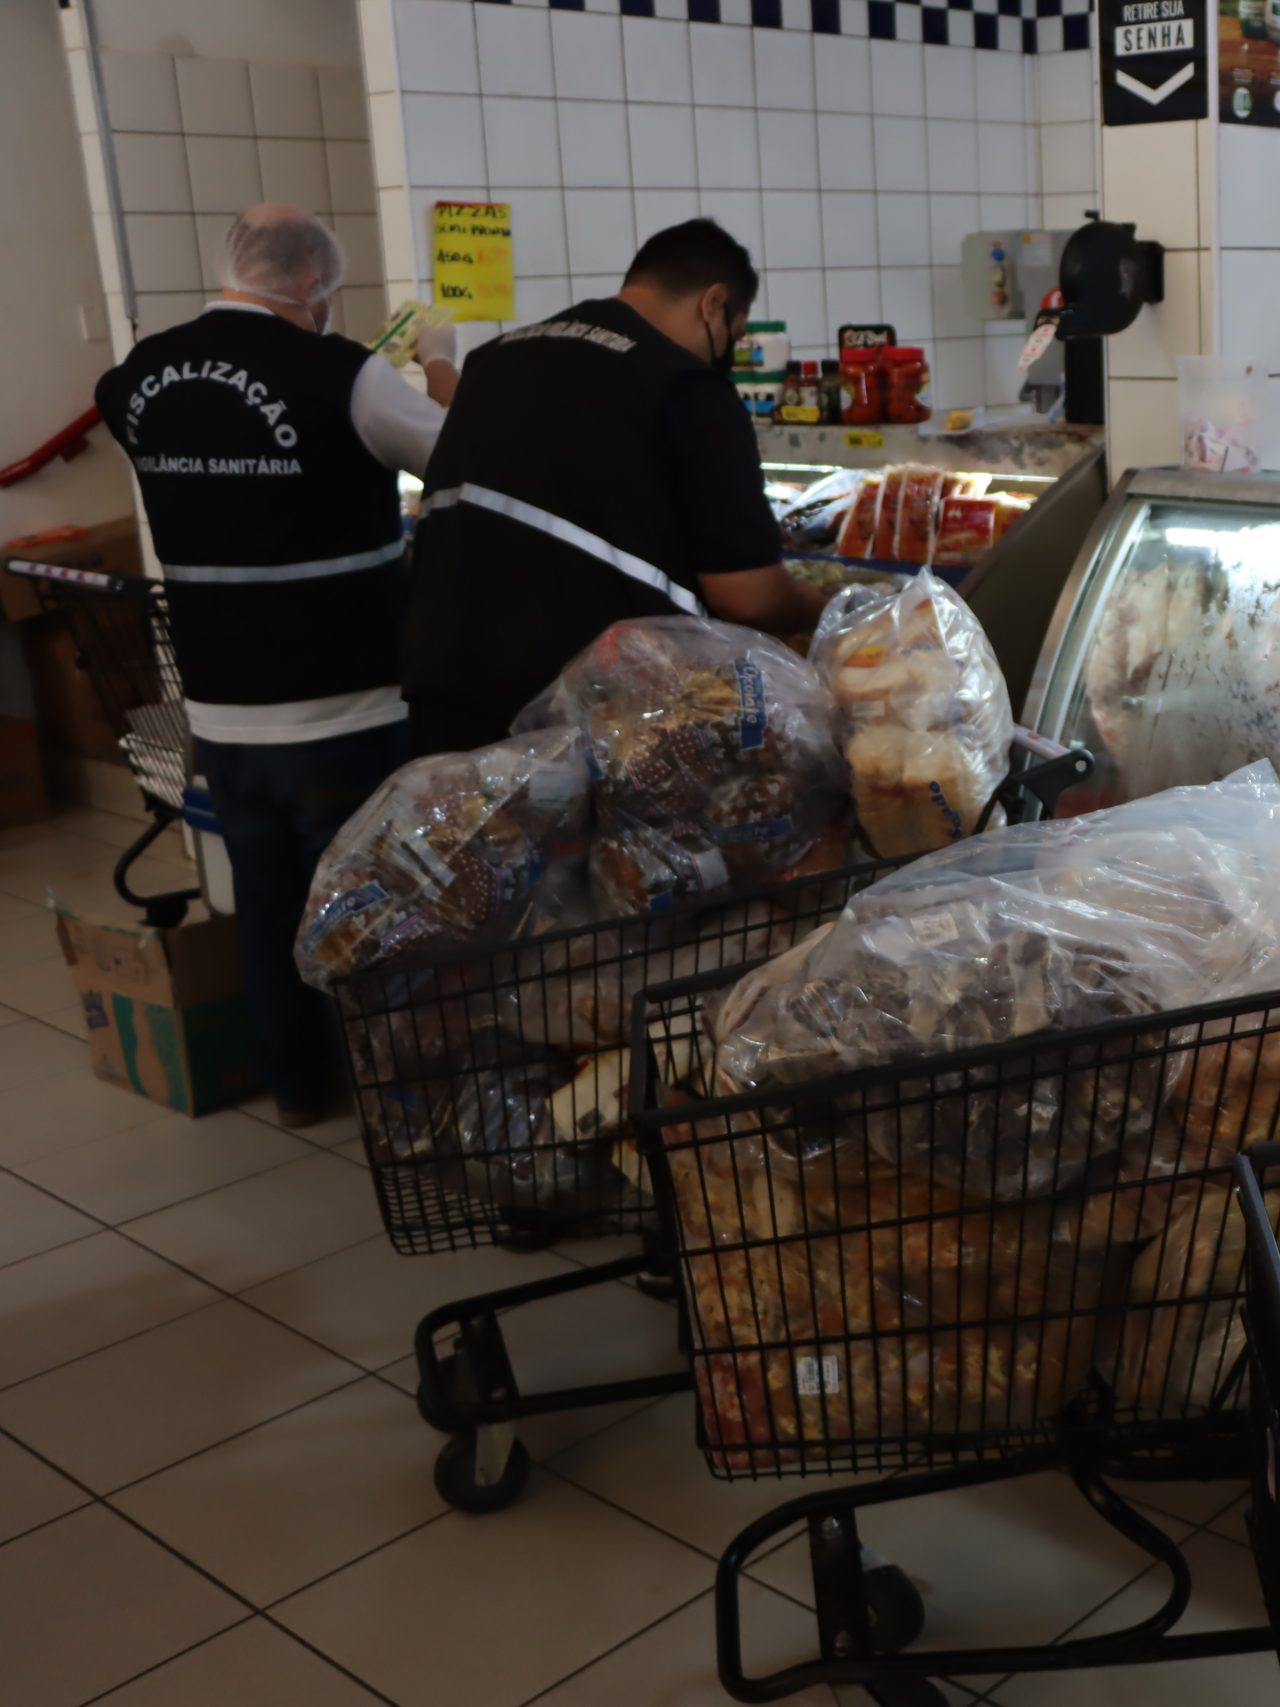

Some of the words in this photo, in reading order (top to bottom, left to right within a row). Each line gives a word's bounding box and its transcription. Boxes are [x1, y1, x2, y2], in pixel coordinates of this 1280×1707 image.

[1123, 2, 1159, 22] RETIRE
[1161, 0, 1184, 18] SUA
[1124, 23, 1185, 51] SENHA
[208, 455, 303, 475] SANITÁRIA
